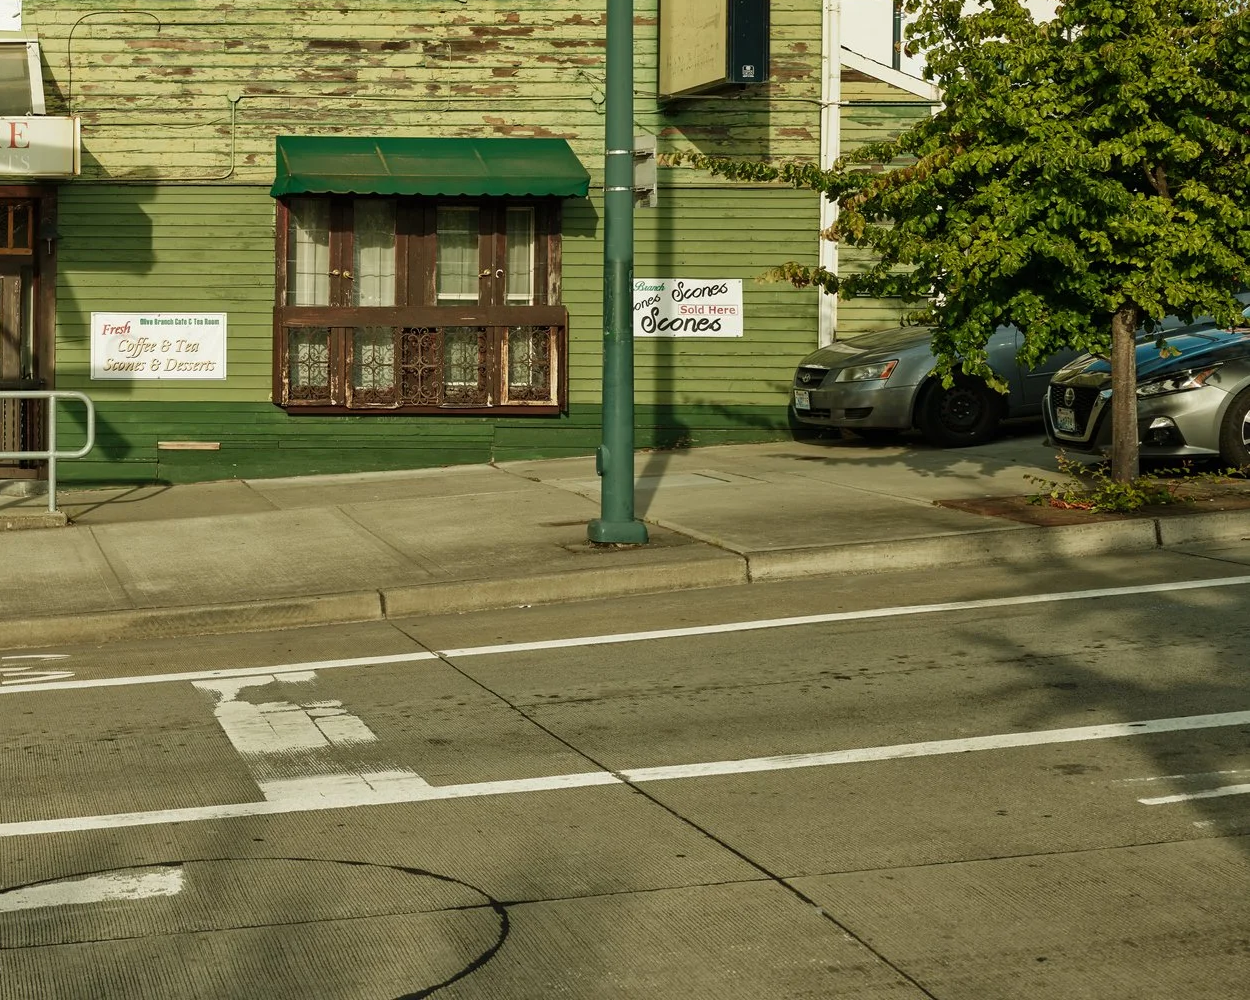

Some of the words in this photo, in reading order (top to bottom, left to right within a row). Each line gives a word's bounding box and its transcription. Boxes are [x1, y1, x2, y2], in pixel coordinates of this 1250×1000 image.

[633, 281, 665, 291] Branch
[671, 281, 728, 302] Scones
[633, 294, 661, 311] ones
[680, 305, 704, 315] Sold
[708, 305, 736, 315] Here
[102, 320, 131, 335] Fresh
[641, 306, 722, 334] Scones
[118, 337, 157, 358] Coffee
[161, 340, 172, 352] &
[175, 340, 200, 353] Tea
[103, 358, 146, 371] Scones
[150, 358, 161, 371] &
[163, 358, 216, 371] Desserts
